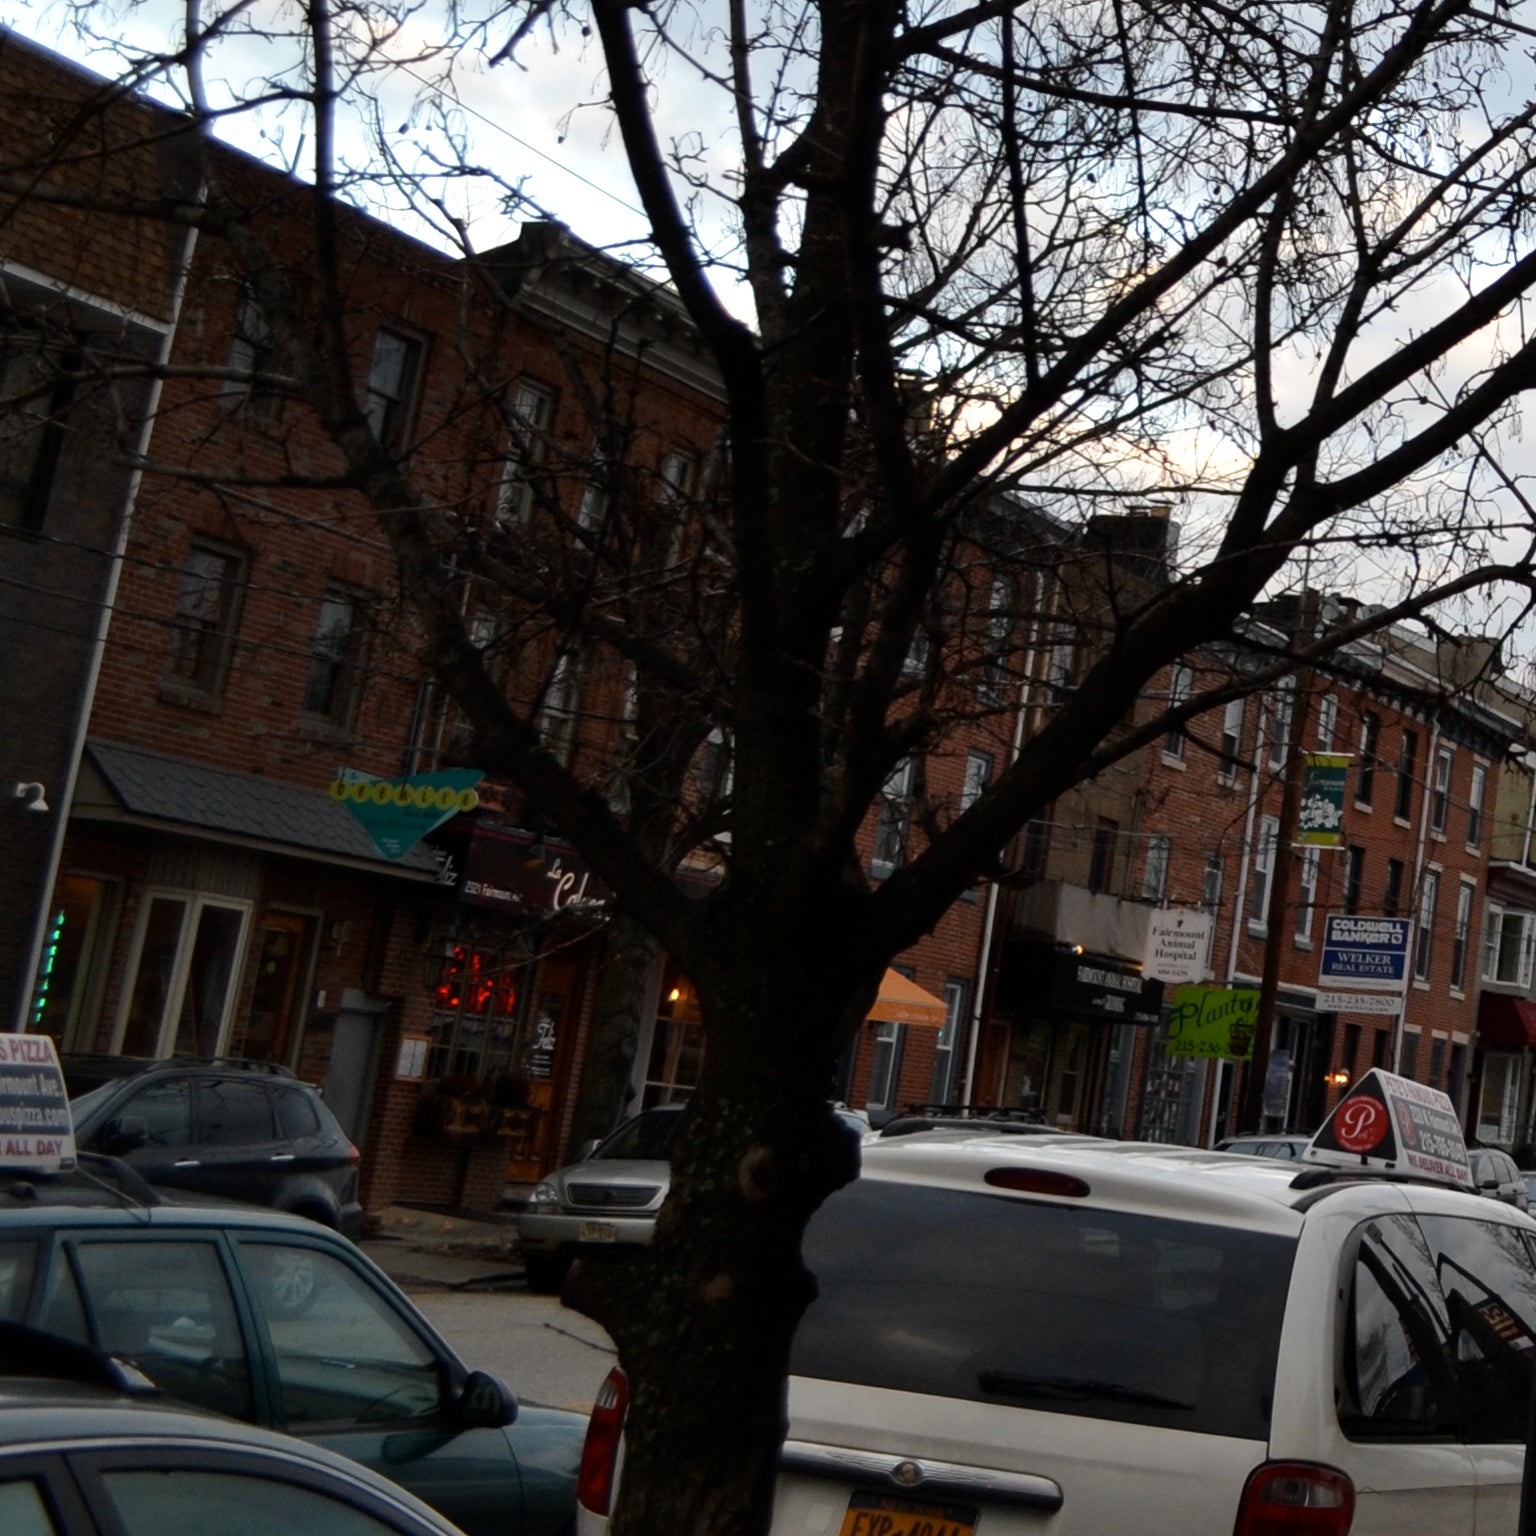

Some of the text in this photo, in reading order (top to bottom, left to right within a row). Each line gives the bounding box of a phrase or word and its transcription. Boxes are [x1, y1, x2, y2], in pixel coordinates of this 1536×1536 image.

[1152, 926, 1205, 939] Fairmount
[1332, 918, 1404, 933] COLDWELL
[1161, 938, 1196, 949] Animal
[1331, 929, 1390, 944] BANKER
[1154, 948, 1197, 961] Hospital
[1337, 951, 1392, 965] WELKER
[1331, 961, 1395, 974] REAL ESTATE
[10, 1040, 54, 1064] PIZZA
[6, 1140, 64, 1157] ALL DAY
